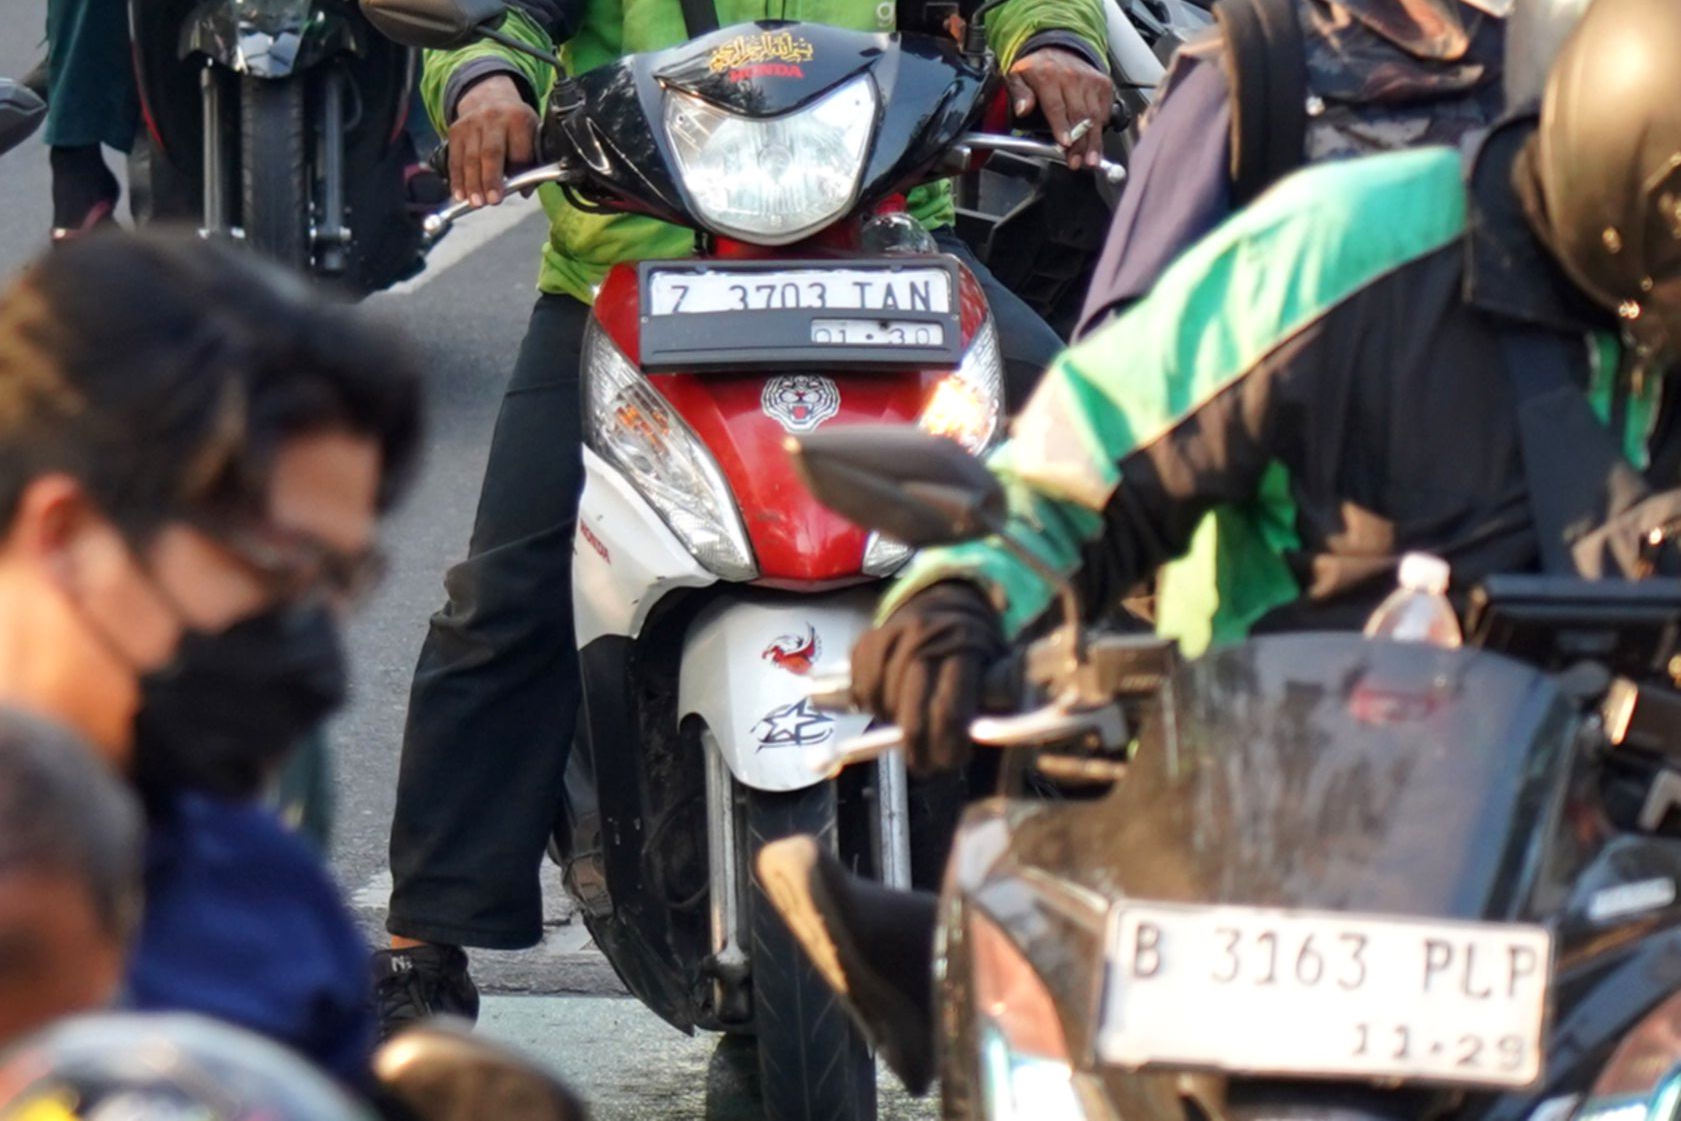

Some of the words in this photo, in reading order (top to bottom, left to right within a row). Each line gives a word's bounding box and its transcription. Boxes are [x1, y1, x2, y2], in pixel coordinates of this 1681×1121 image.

[671, 285, 689, 312] Z
[728, 282, 827, 310] 3703
[852, 280, 933, 311] TAN
[1134, 922, 1162, 979] B
[1212, 927, 1369, 991] 3163
[1422, 938, 1538, 1000] PLP
